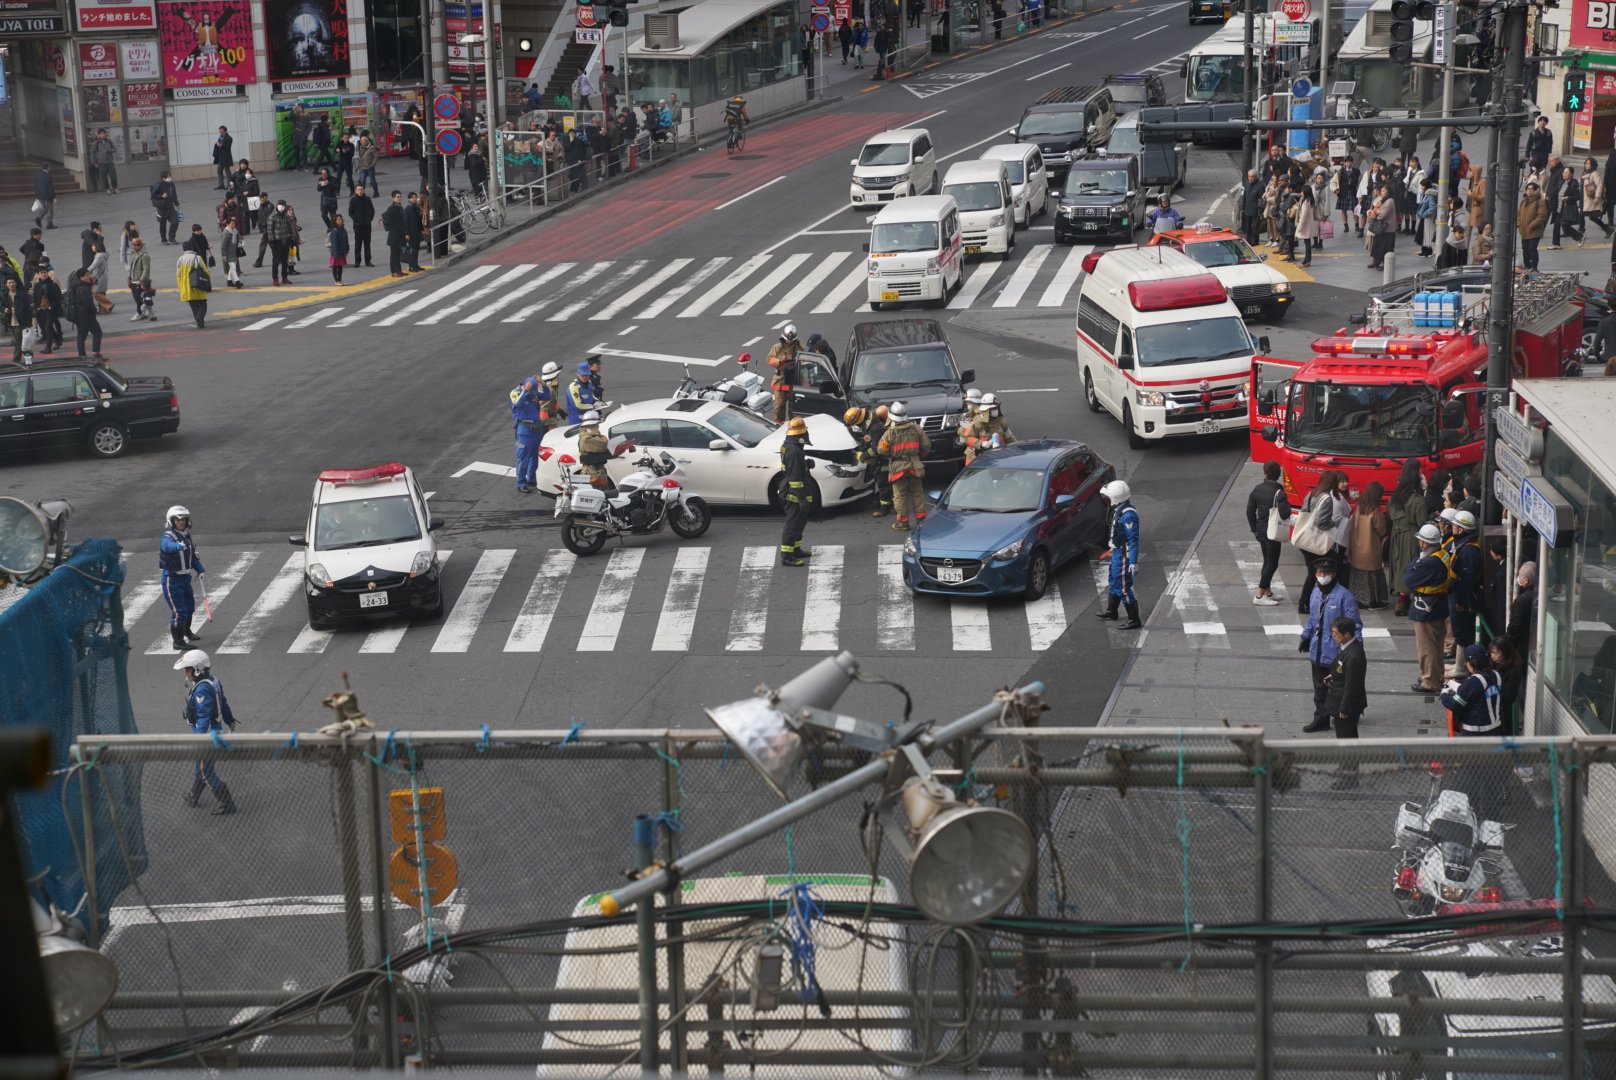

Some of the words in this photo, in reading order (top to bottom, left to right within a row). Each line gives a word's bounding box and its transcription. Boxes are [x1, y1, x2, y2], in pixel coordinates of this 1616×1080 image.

[1284, 3, 1304, 13] 消火栓
[82, 12, 151, 22] ランチ始めました。
[27, 19, 54, 30] TOEI
[577, 33, 601, 41] KEN
[127, 83, 158, 92] カラオケ
[284, 82, 314, 91] COMING
[315, 80, 336, 89] SOON
[176, 89, 209, 98] COMING
[211, 87, 234, 96] SOON
[1256, 416, 1274, 424] TOKYO
[366, 597, 387, 606] 24-33
